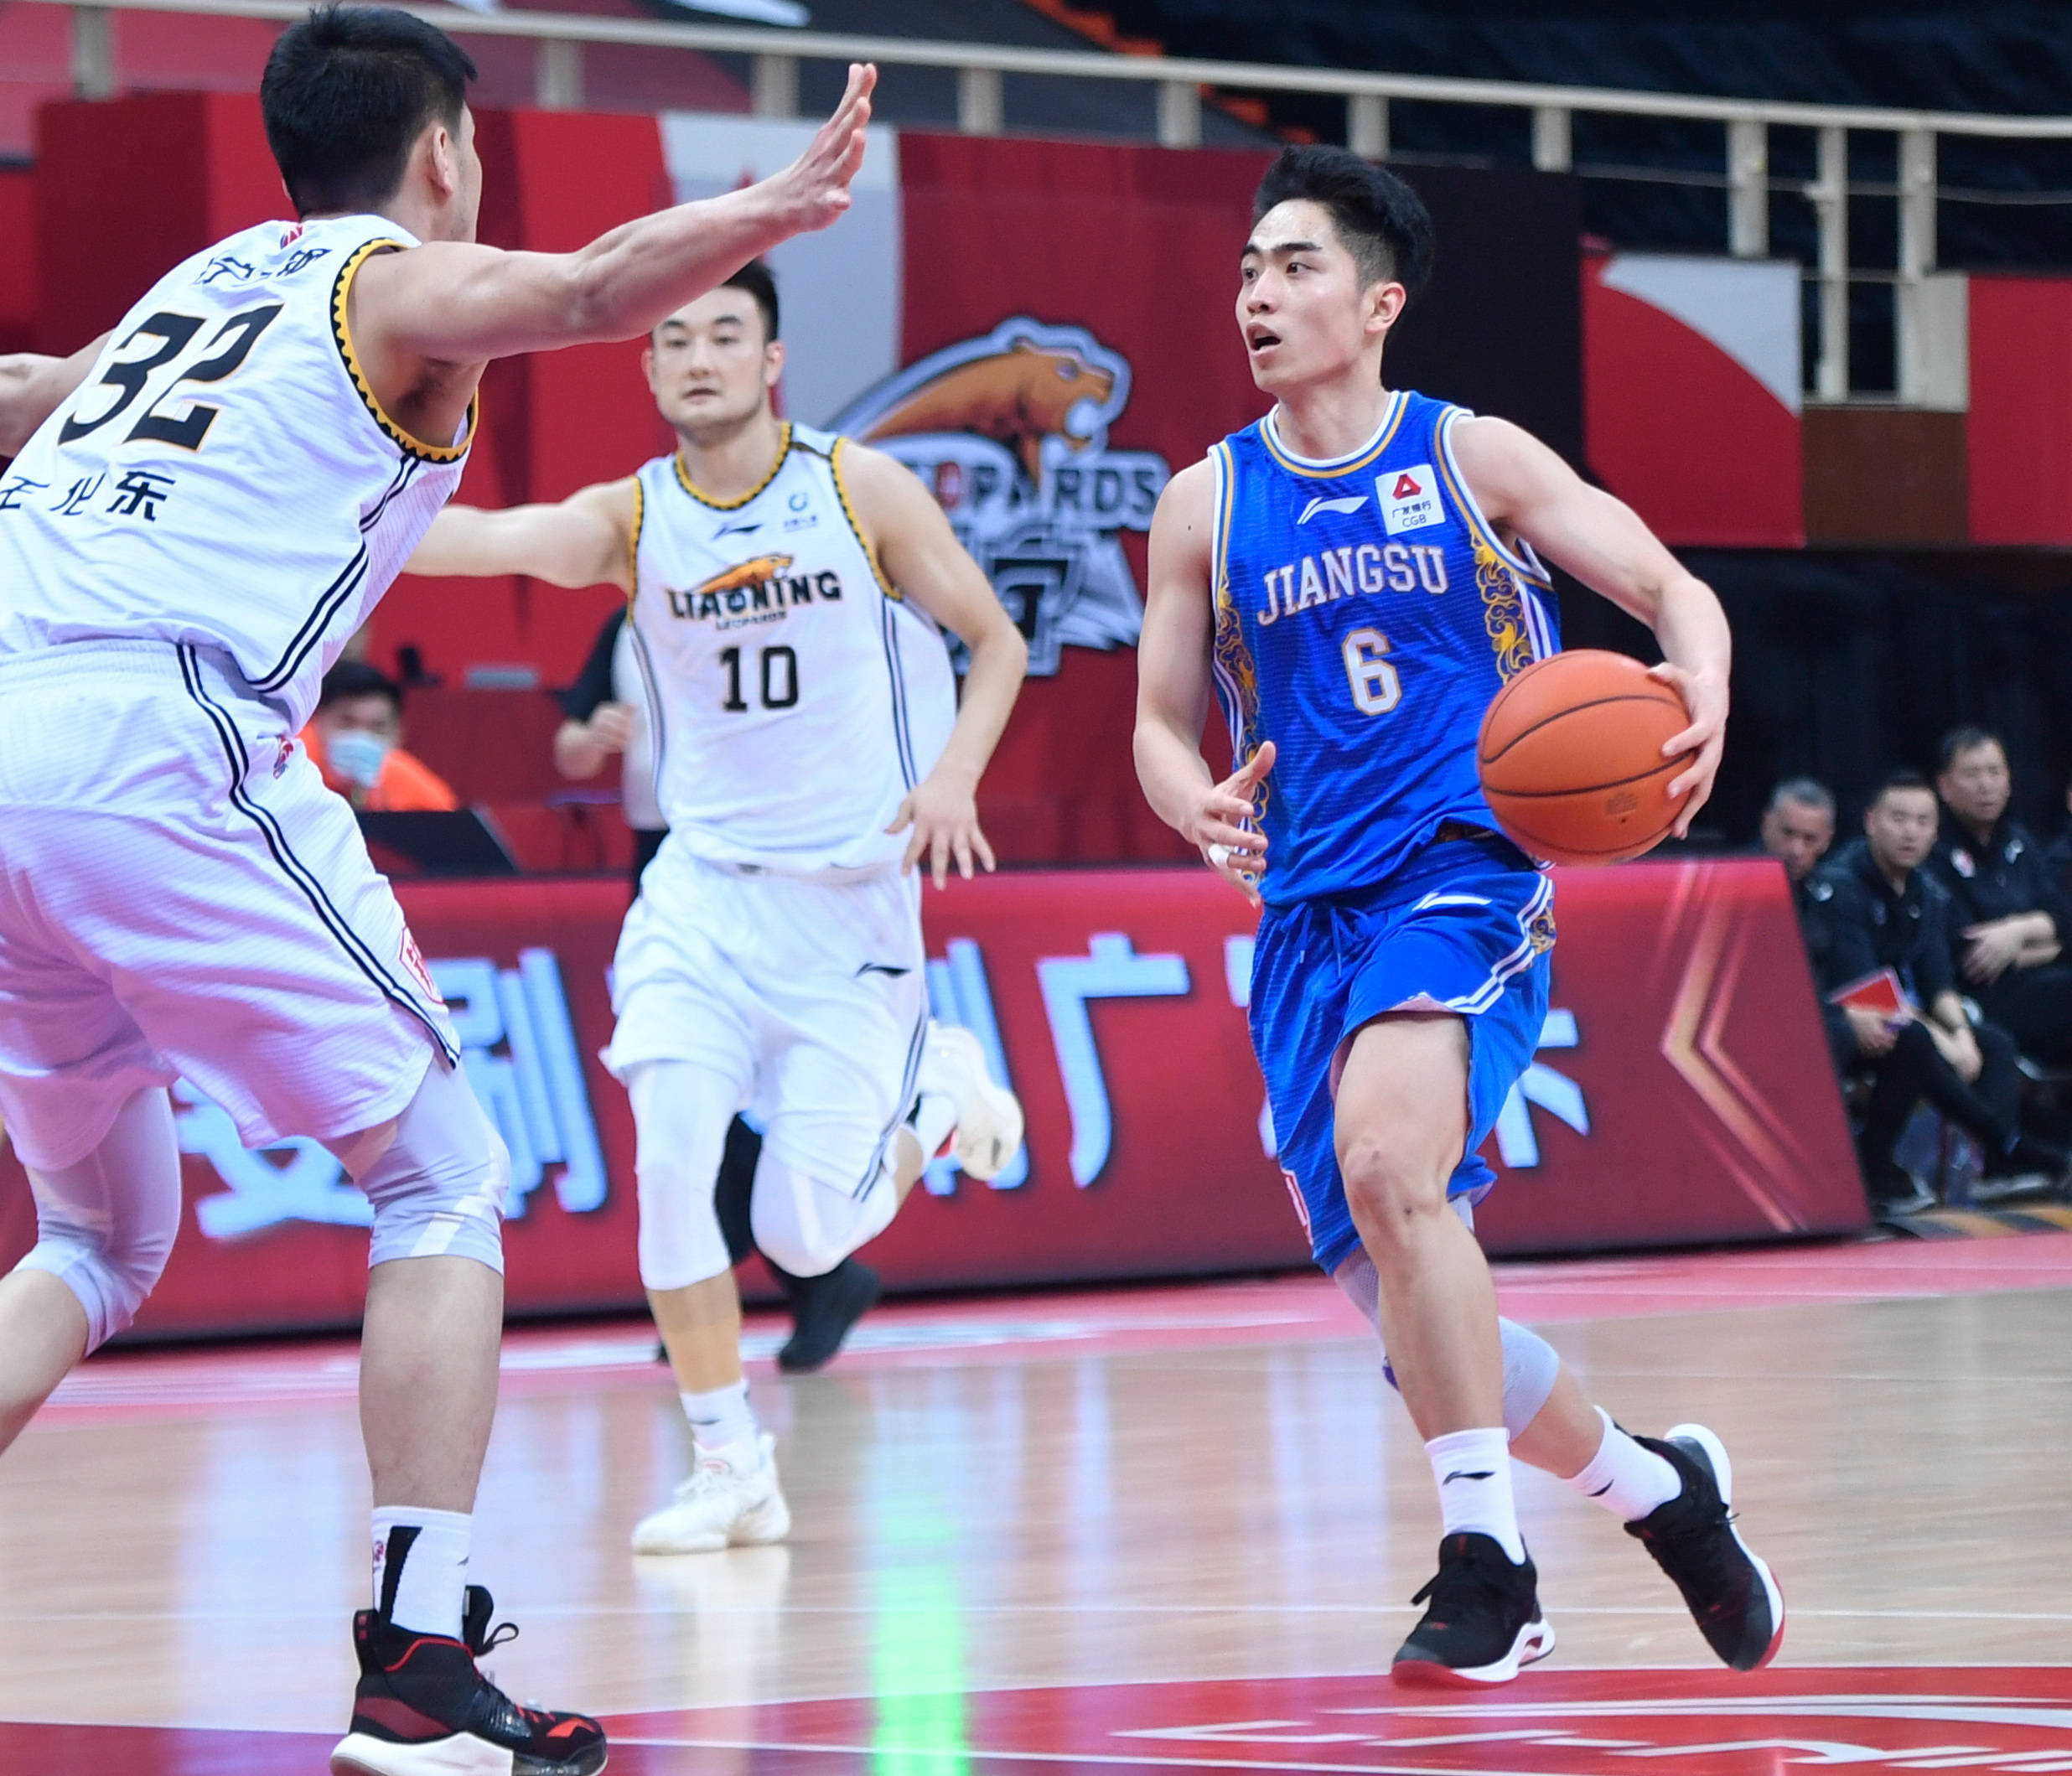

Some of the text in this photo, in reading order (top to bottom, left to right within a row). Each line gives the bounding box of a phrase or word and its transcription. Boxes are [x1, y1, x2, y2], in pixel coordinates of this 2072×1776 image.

[58, 303, 286, 454] 32
[1402, 514, 1427, 527] CGB
[668, 569, 842, 620] LIAONING
[1257, 543, 1449, 627] JIANGSU
[718, 645, 800, 712] 10
[1343, 627, 1402, 717] 6
